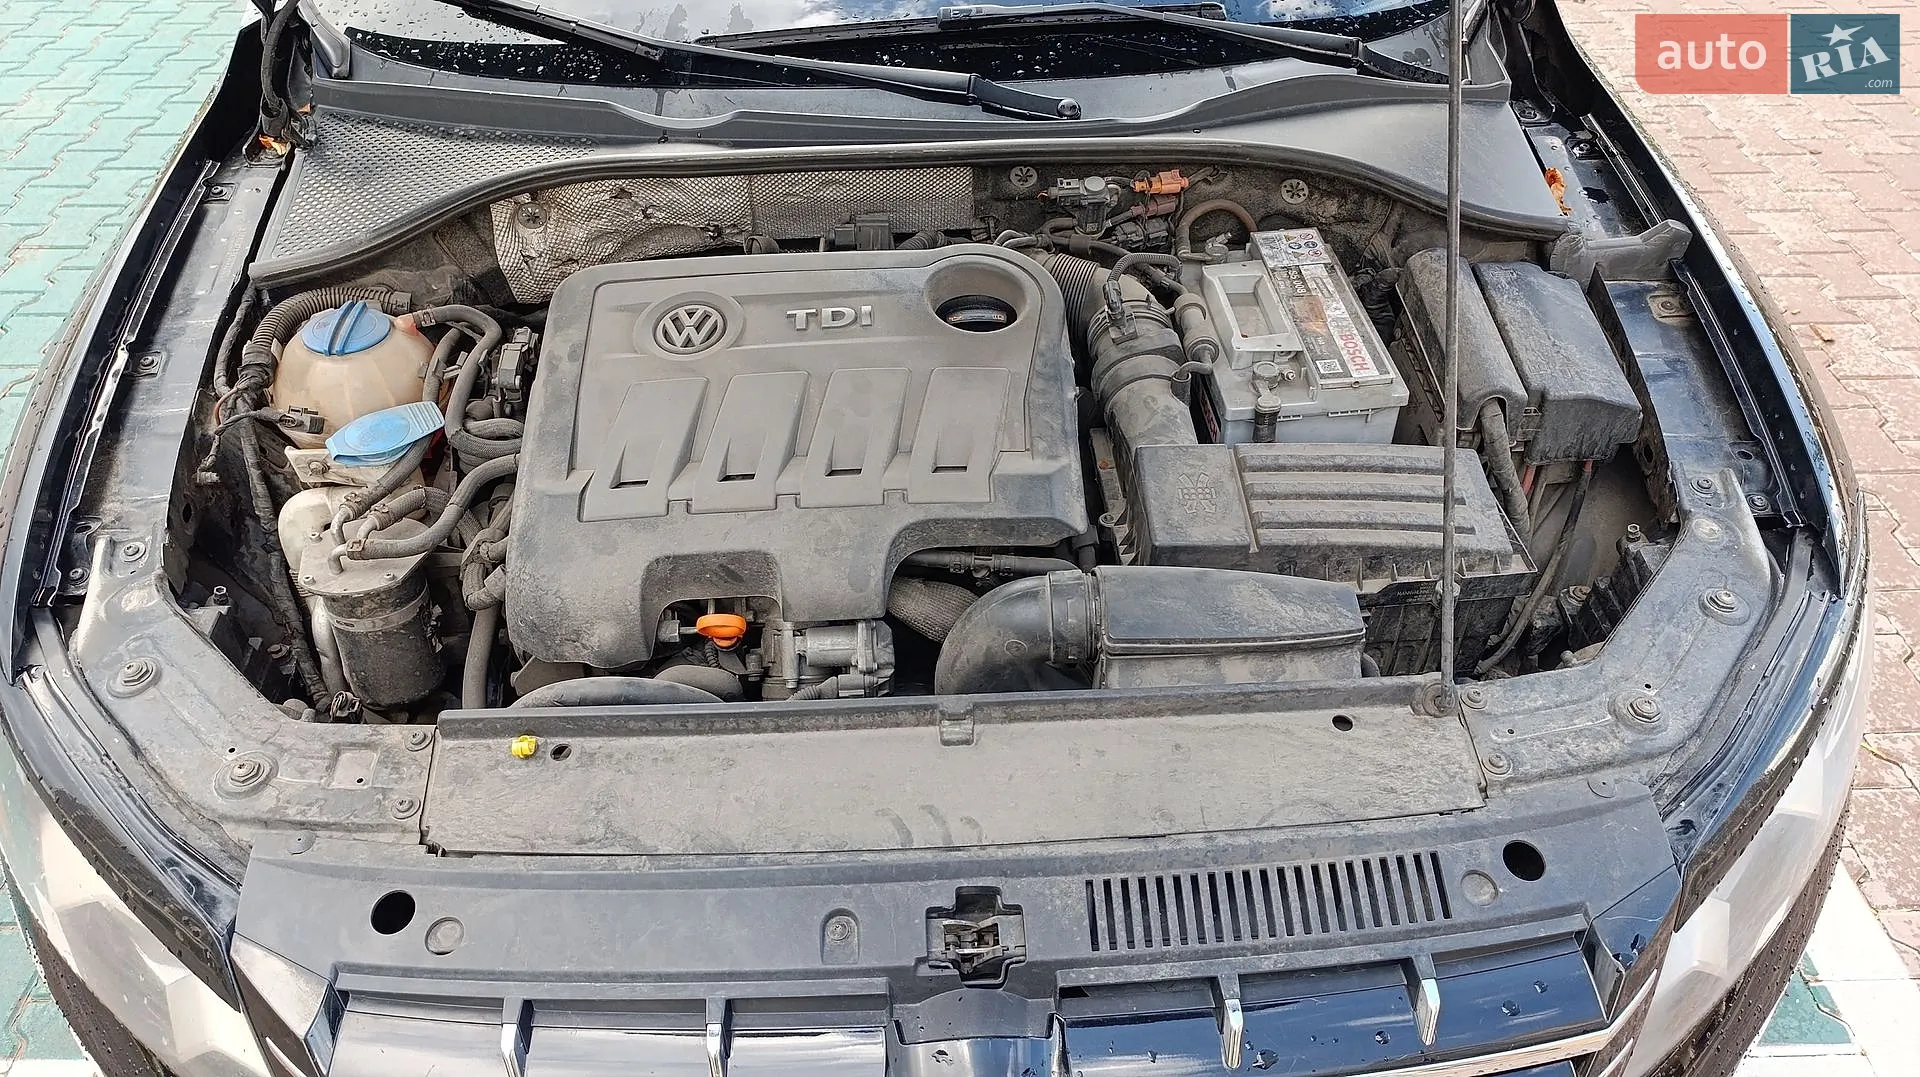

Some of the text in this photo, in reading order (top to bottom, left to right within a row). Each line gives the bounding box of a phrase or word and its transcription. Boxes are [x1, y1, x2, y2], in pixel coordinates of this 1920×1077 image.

[1293, 281, 1307, 294] 008
[786, 305, 872, 331] TDI
[1339, 333, 1371, 371] BOSCH
